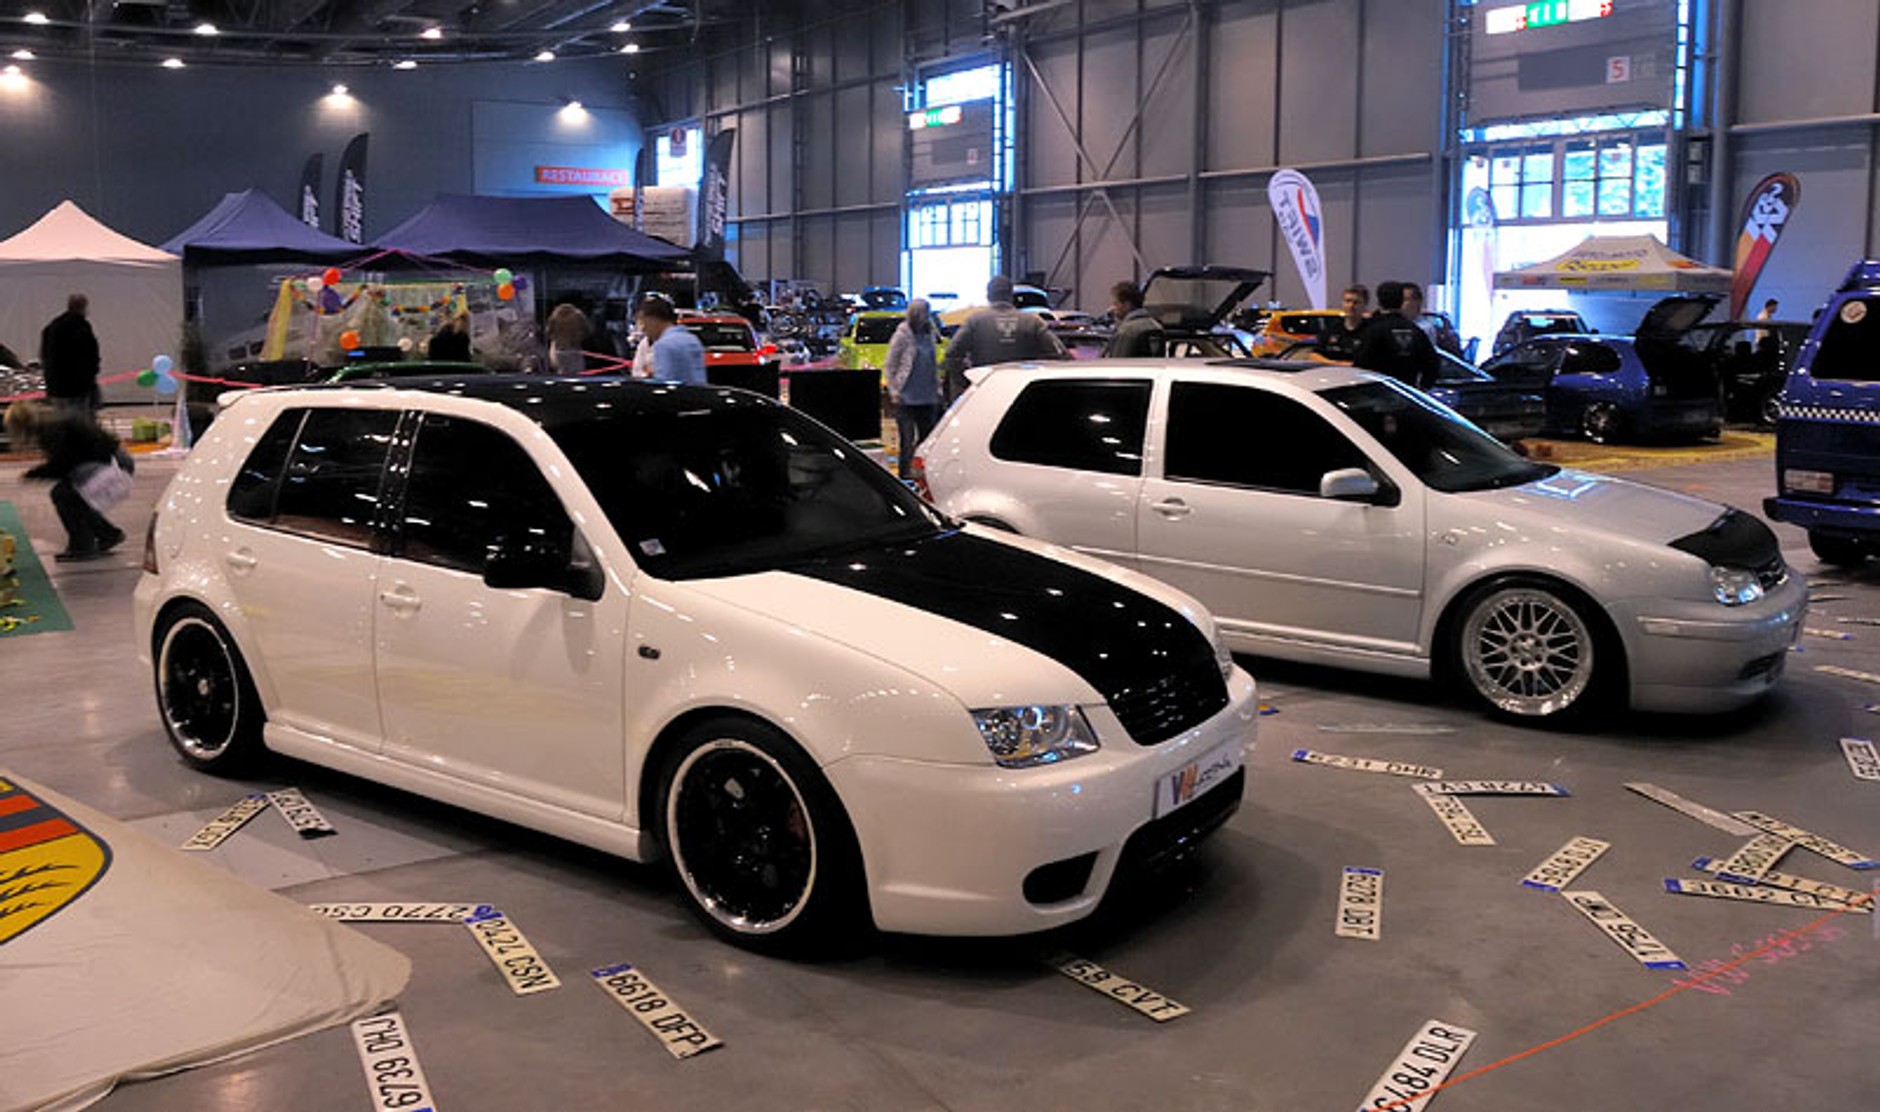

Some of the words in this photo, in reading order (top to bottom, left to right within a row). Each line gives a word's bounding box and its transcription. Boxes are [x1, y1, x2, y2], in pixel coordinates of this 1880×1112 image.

[503, 954, 553, 990] CSN
[606, 974, 669, 1013] 6618
[650, 1013, 709, 1046] DFP
[1111, 984, 1181, 1013] CVT
[1412, 1026, 1468, 1064] DLR
[371, 1051, 424, 1111] 6739
